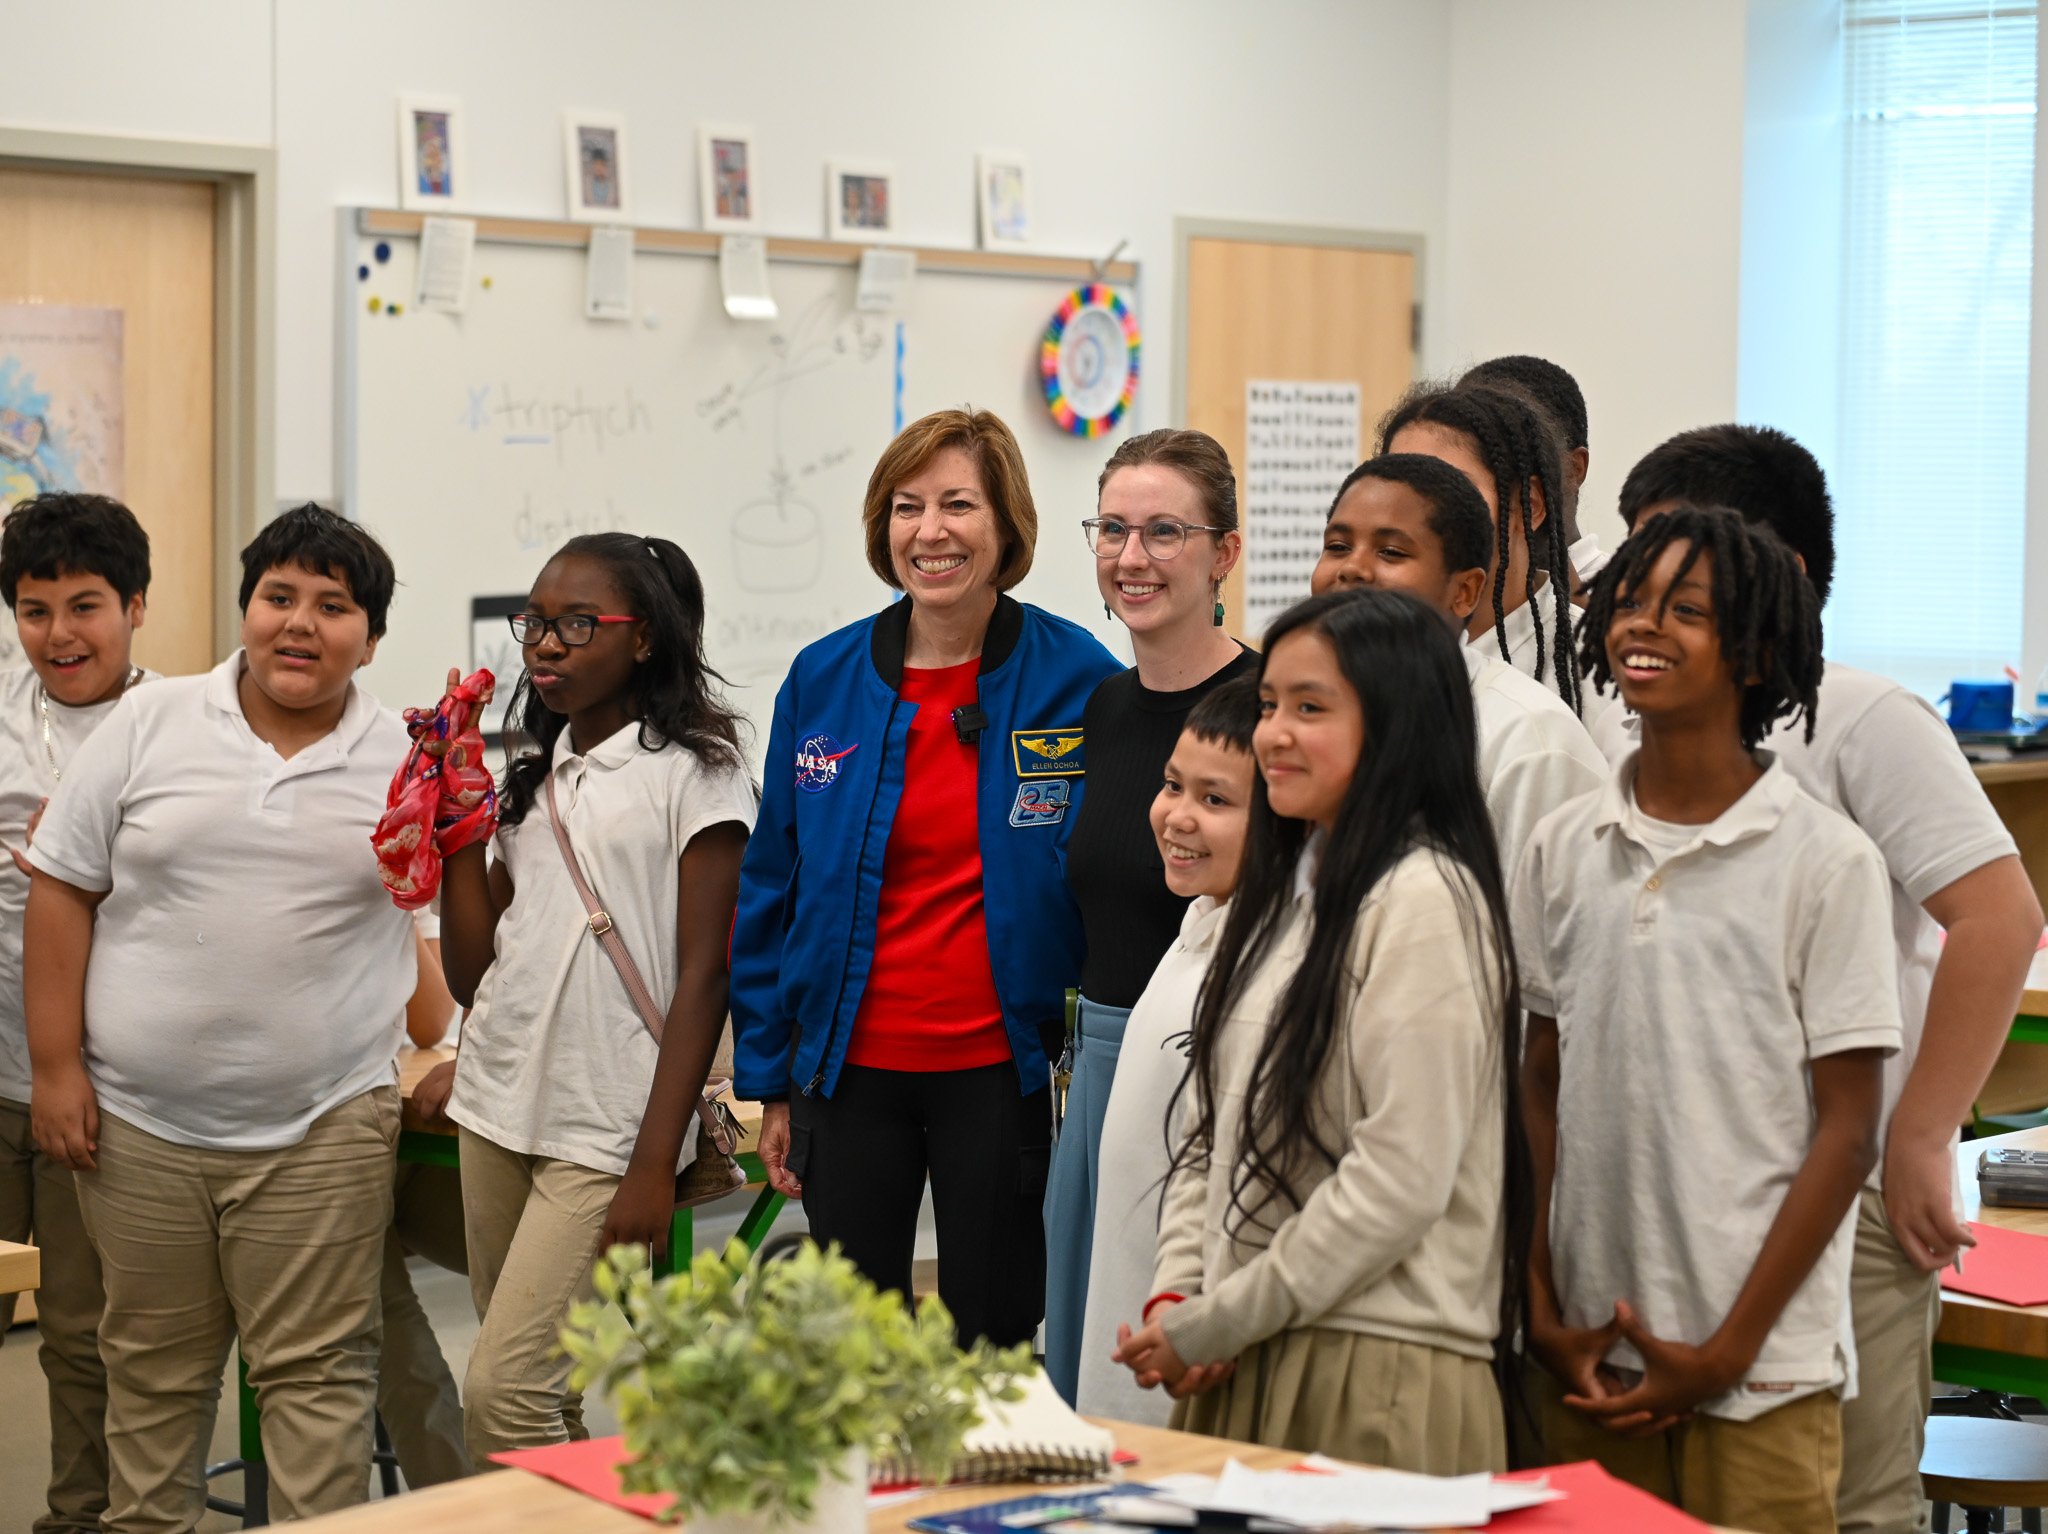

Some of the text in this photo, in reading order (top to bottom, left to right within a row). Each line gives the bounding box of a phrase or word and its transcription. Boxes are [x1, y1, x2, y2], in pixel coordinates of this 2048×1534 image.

[494, 381, 653, 469] triptych
[796, 753, 837, 773] NASA
[1032, 761, 1079, 770] ELLEN OCHOA
[1017, 785, 1061, 821] 25
